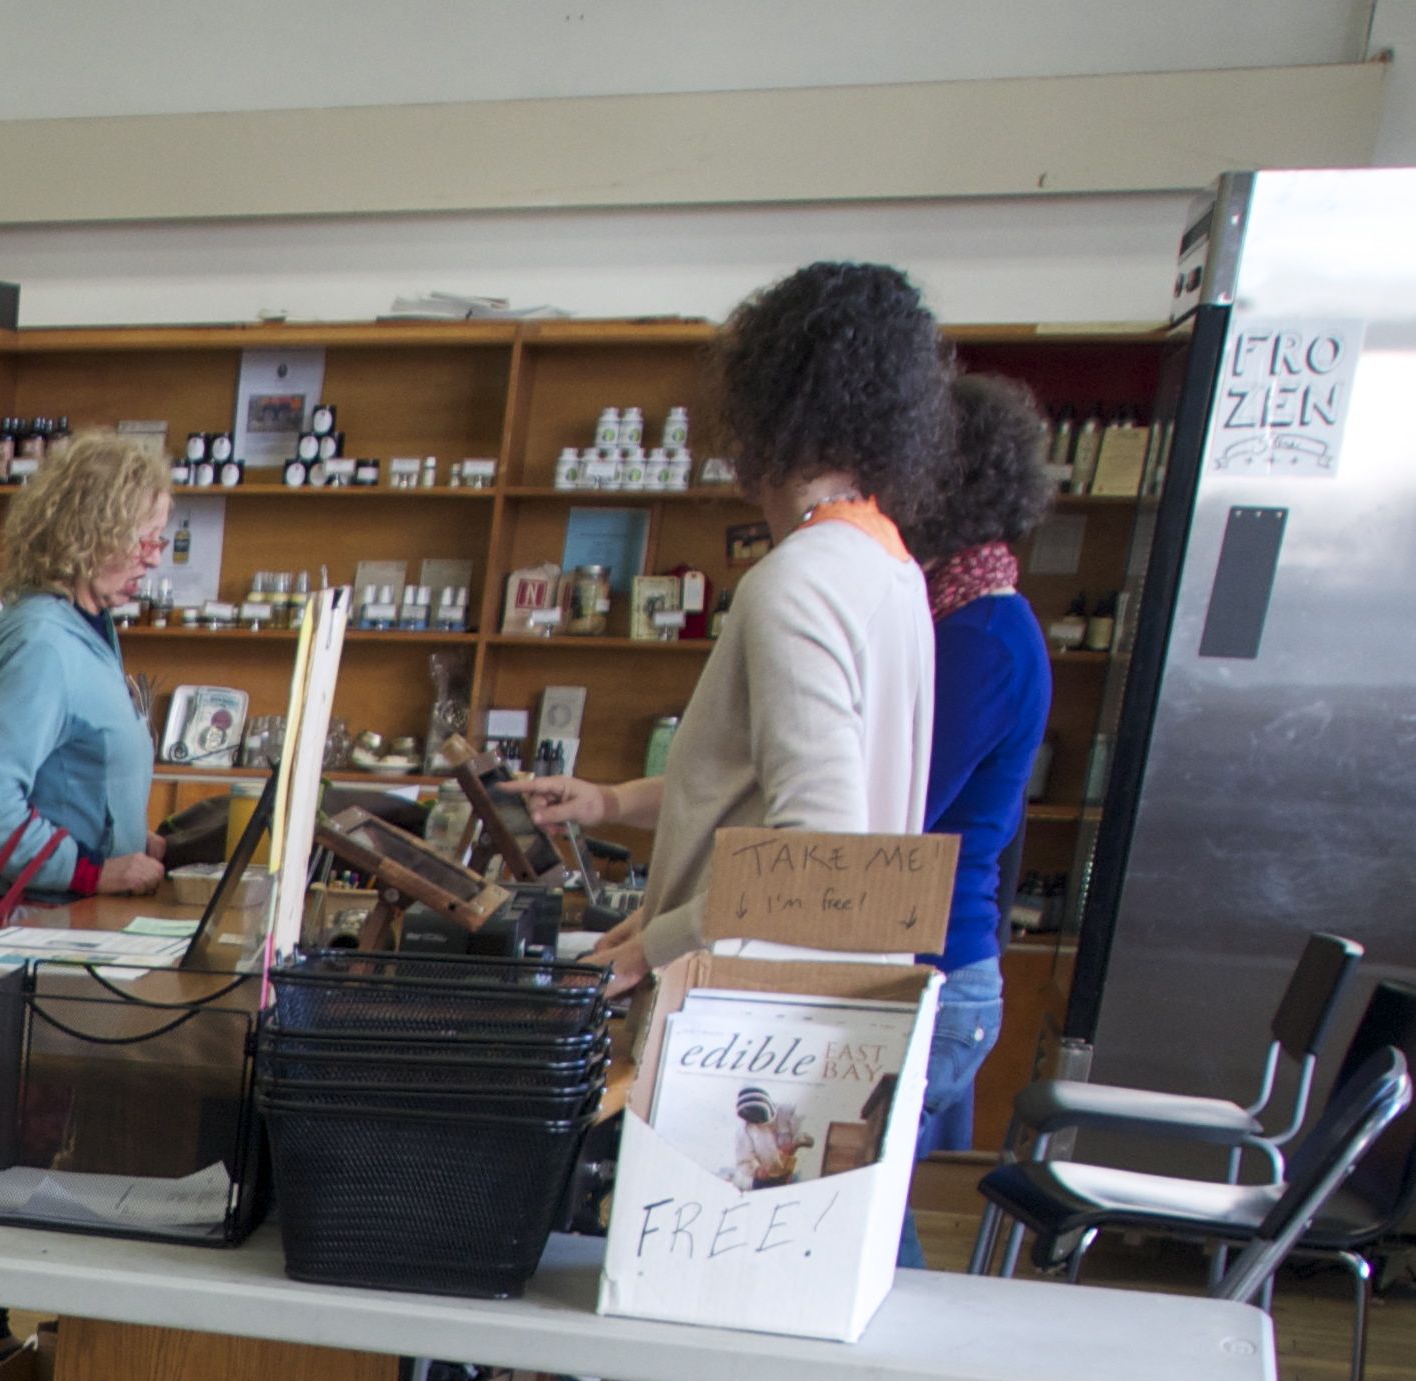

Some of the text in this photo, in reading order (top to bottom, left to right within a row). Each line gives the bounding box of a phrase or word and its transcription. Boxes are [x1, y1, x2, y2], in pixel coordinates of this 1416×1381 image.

[732, 838, 940, 876] TAKE ME!
[767, 886, 868, 914] I'm free!
[680, 1032, 888, 1076] edible EAST
[822, 1062, 886, 1083] BAY
[636, 1190, 839, 1259] FREE!
